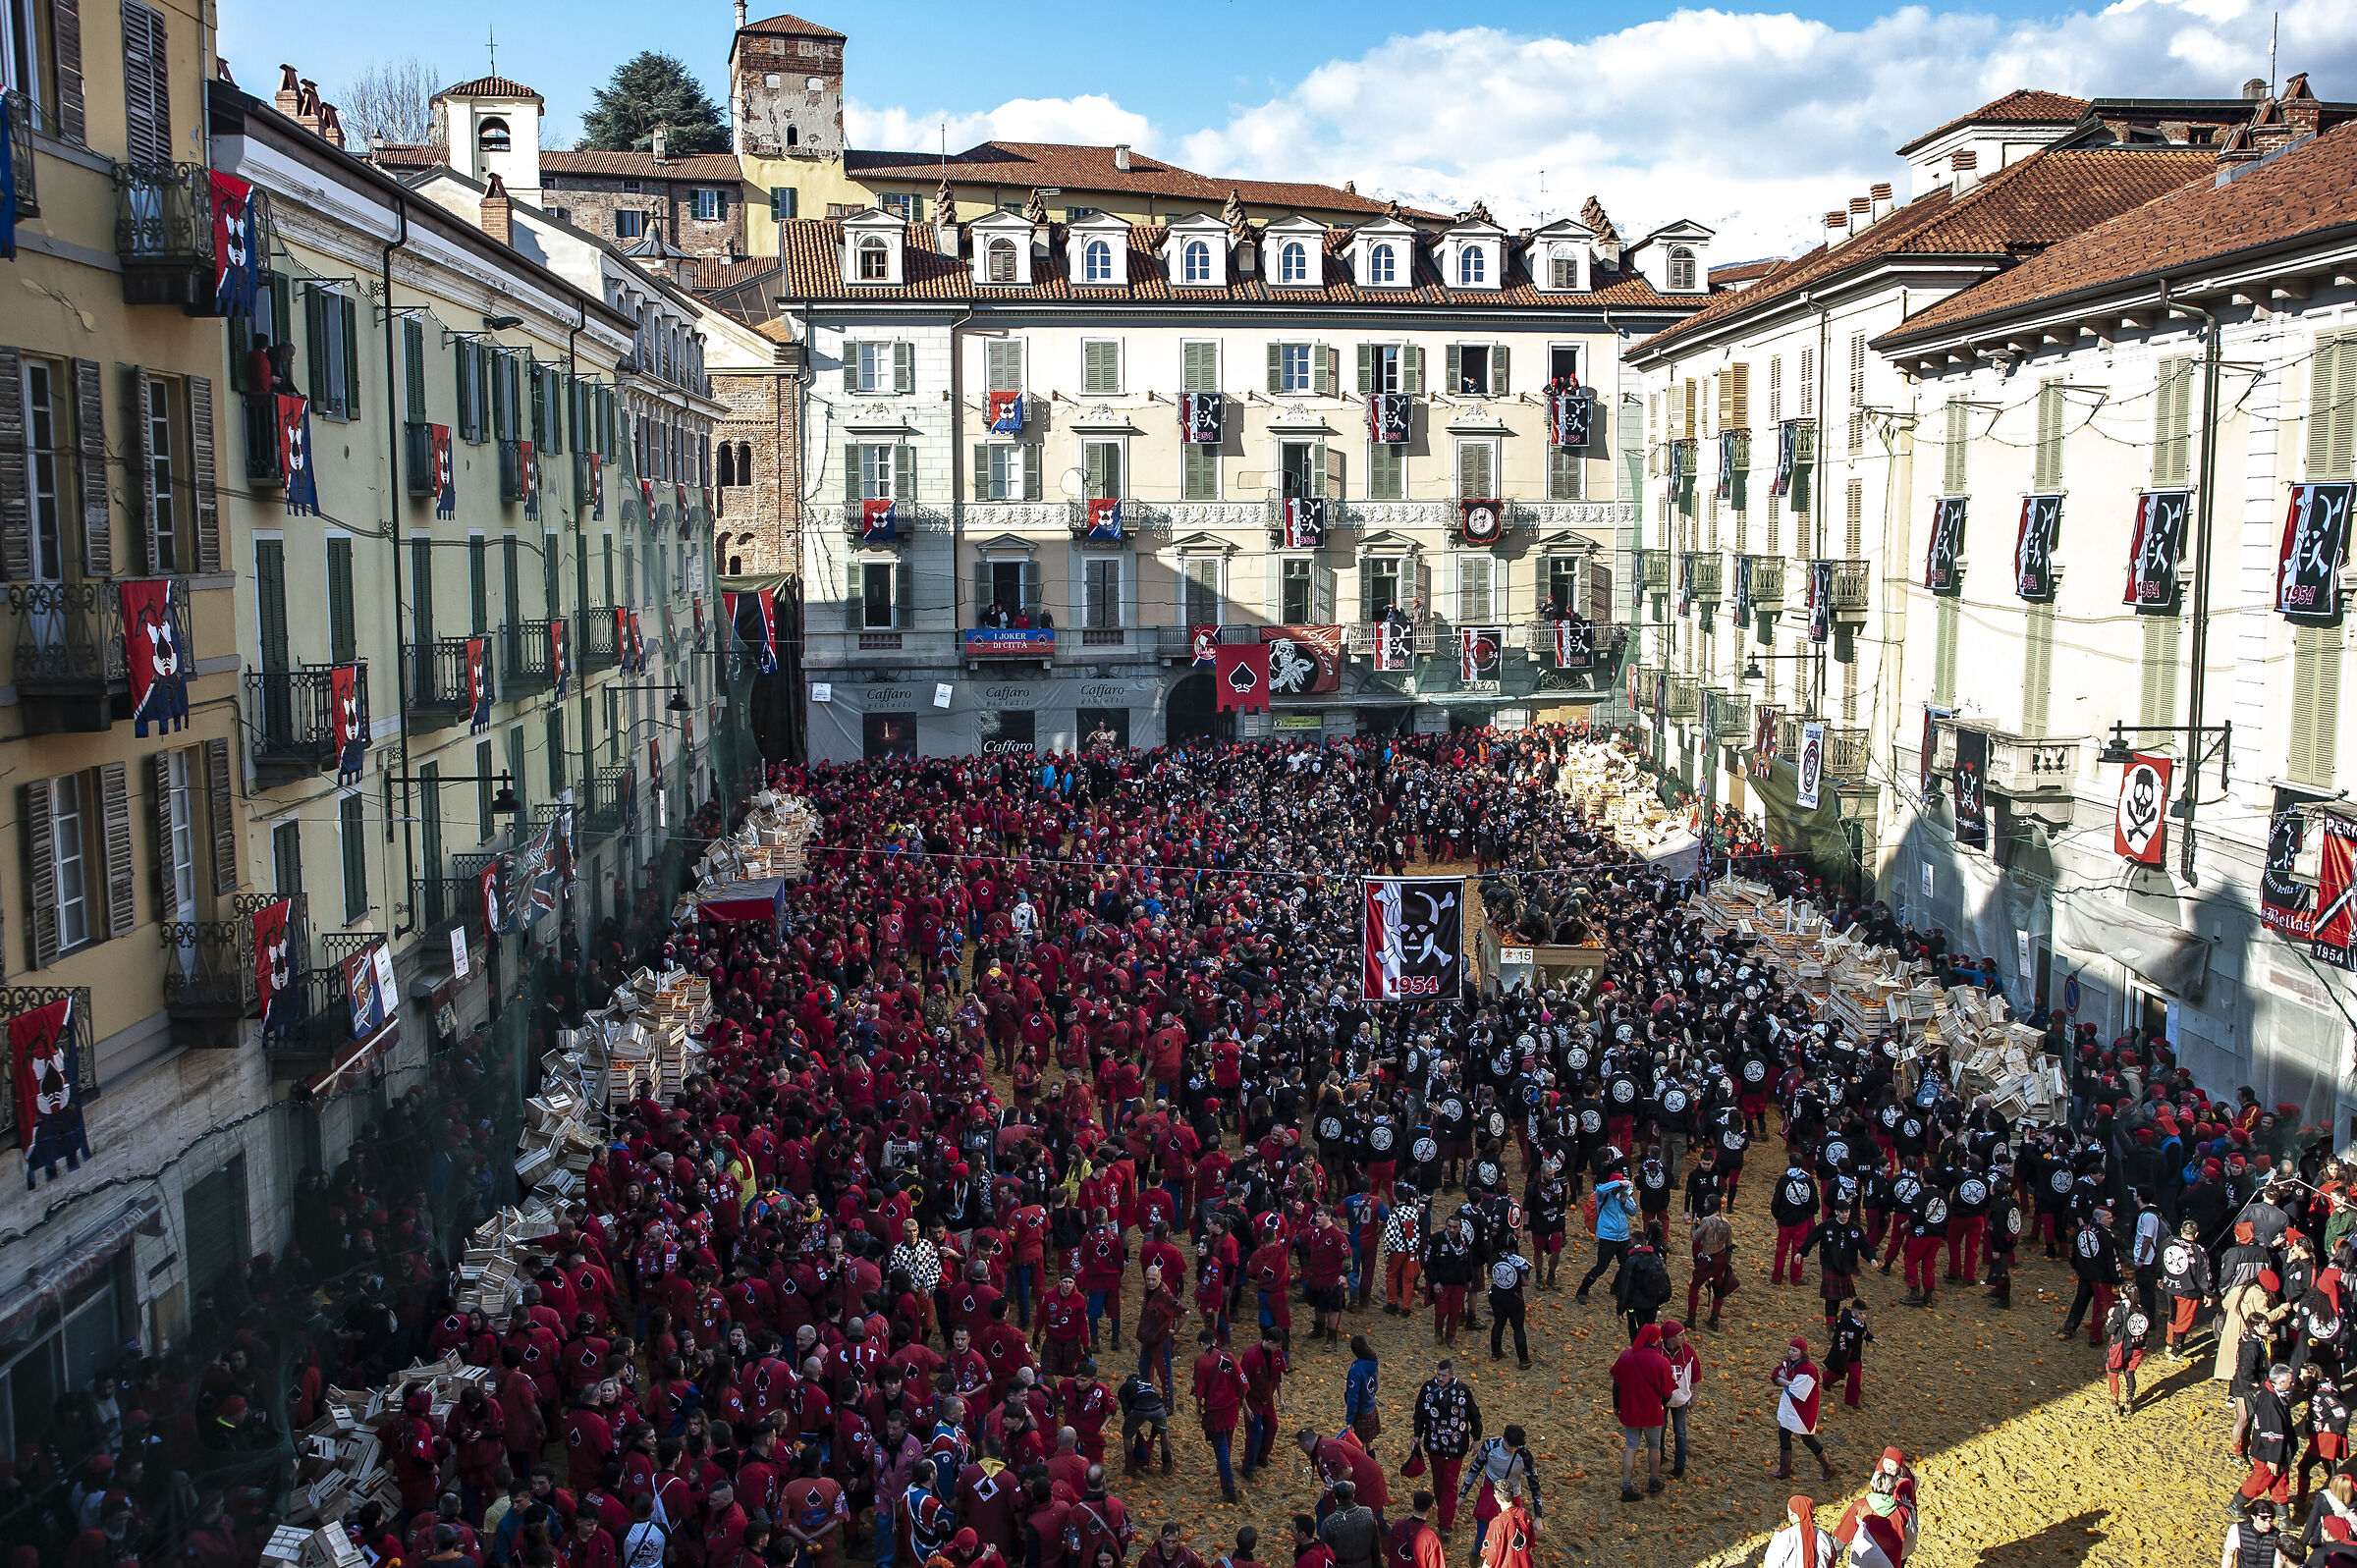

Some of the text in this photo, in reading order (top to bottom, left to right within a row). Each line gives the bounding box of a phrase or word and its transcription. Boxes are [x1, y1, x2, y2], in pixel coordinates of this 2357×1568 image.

[1192, 431, 1213, 441] 1954
[1381, 431, 1401, 441] 1954
[1295, 535, 1316, 545] 1954
[2137, 581, 2161, 599] 1954
[2283, 584, 2317, 605] 1954
[1385, 659, 1404, 668] 1954
[1565, 656, 1585, 665] 1954
[866, 688, 912, 702] Caffaro
[986, 686, 1030, 700] Caffaro
[1080, 682, 1124, 697] Caffaro
[983, 739, 1033, 755] Caffaro
[1518, 950, 1531, 961] 15
[2316, 944, 2344, 964] 1954
[1389, 975, 1439, 994] 1954
